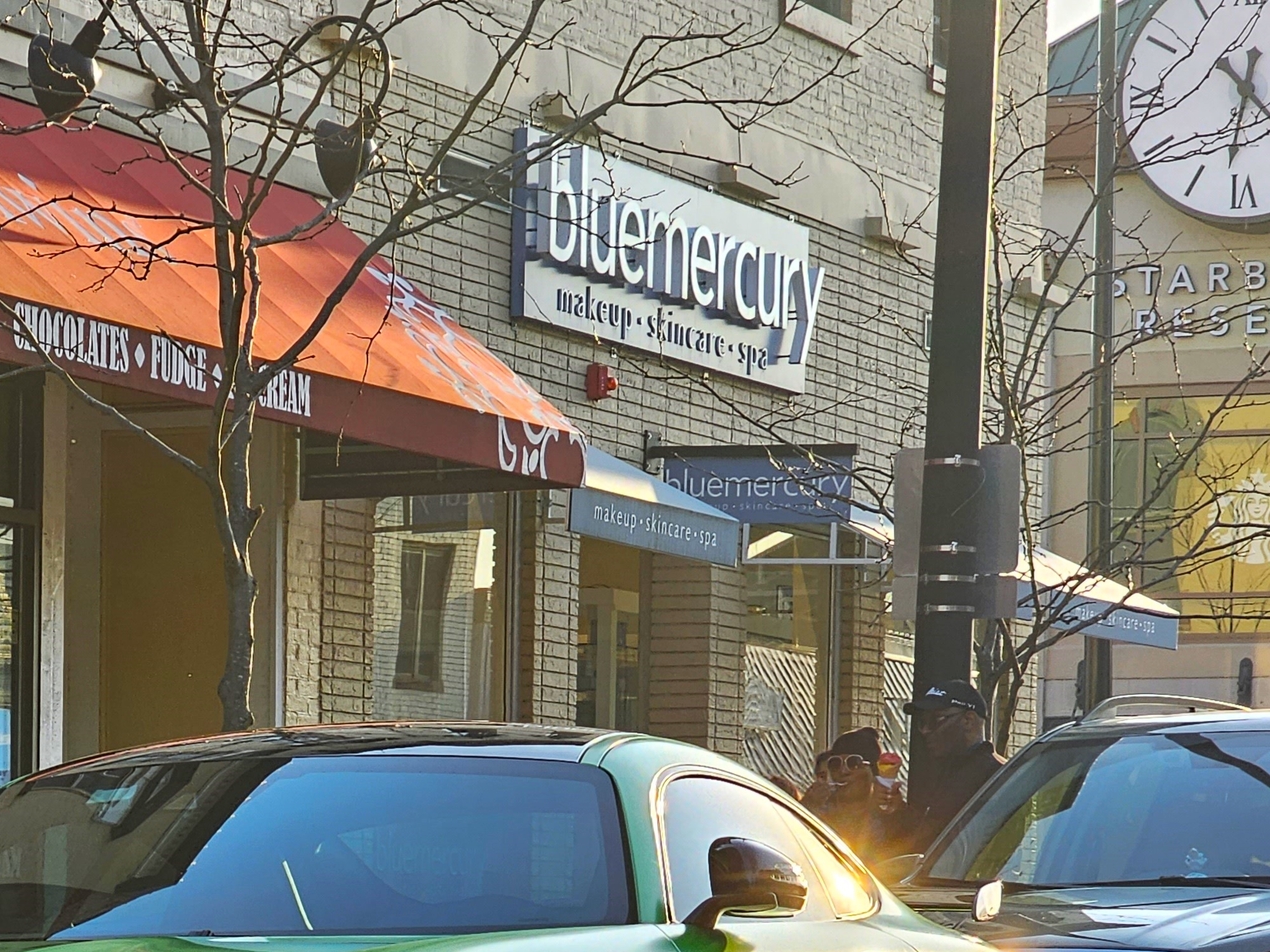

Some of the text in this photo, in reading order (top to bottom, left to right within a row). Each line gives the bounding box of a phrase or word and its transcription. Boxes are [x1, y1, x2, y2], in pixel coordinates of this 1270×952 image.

[549, 140, 825, 364] bluemercury
[13, 301, 130, 373] CHOCOLATES
[150, 334, 207, 393] FUDGE
[556, 286, 768, 375] makeup skincare spa
[666, 468, 849, 503] bluemercury
[594, 504, 717, 550] makeup skincare spa
[1143, 620, 1156, 637] spa
